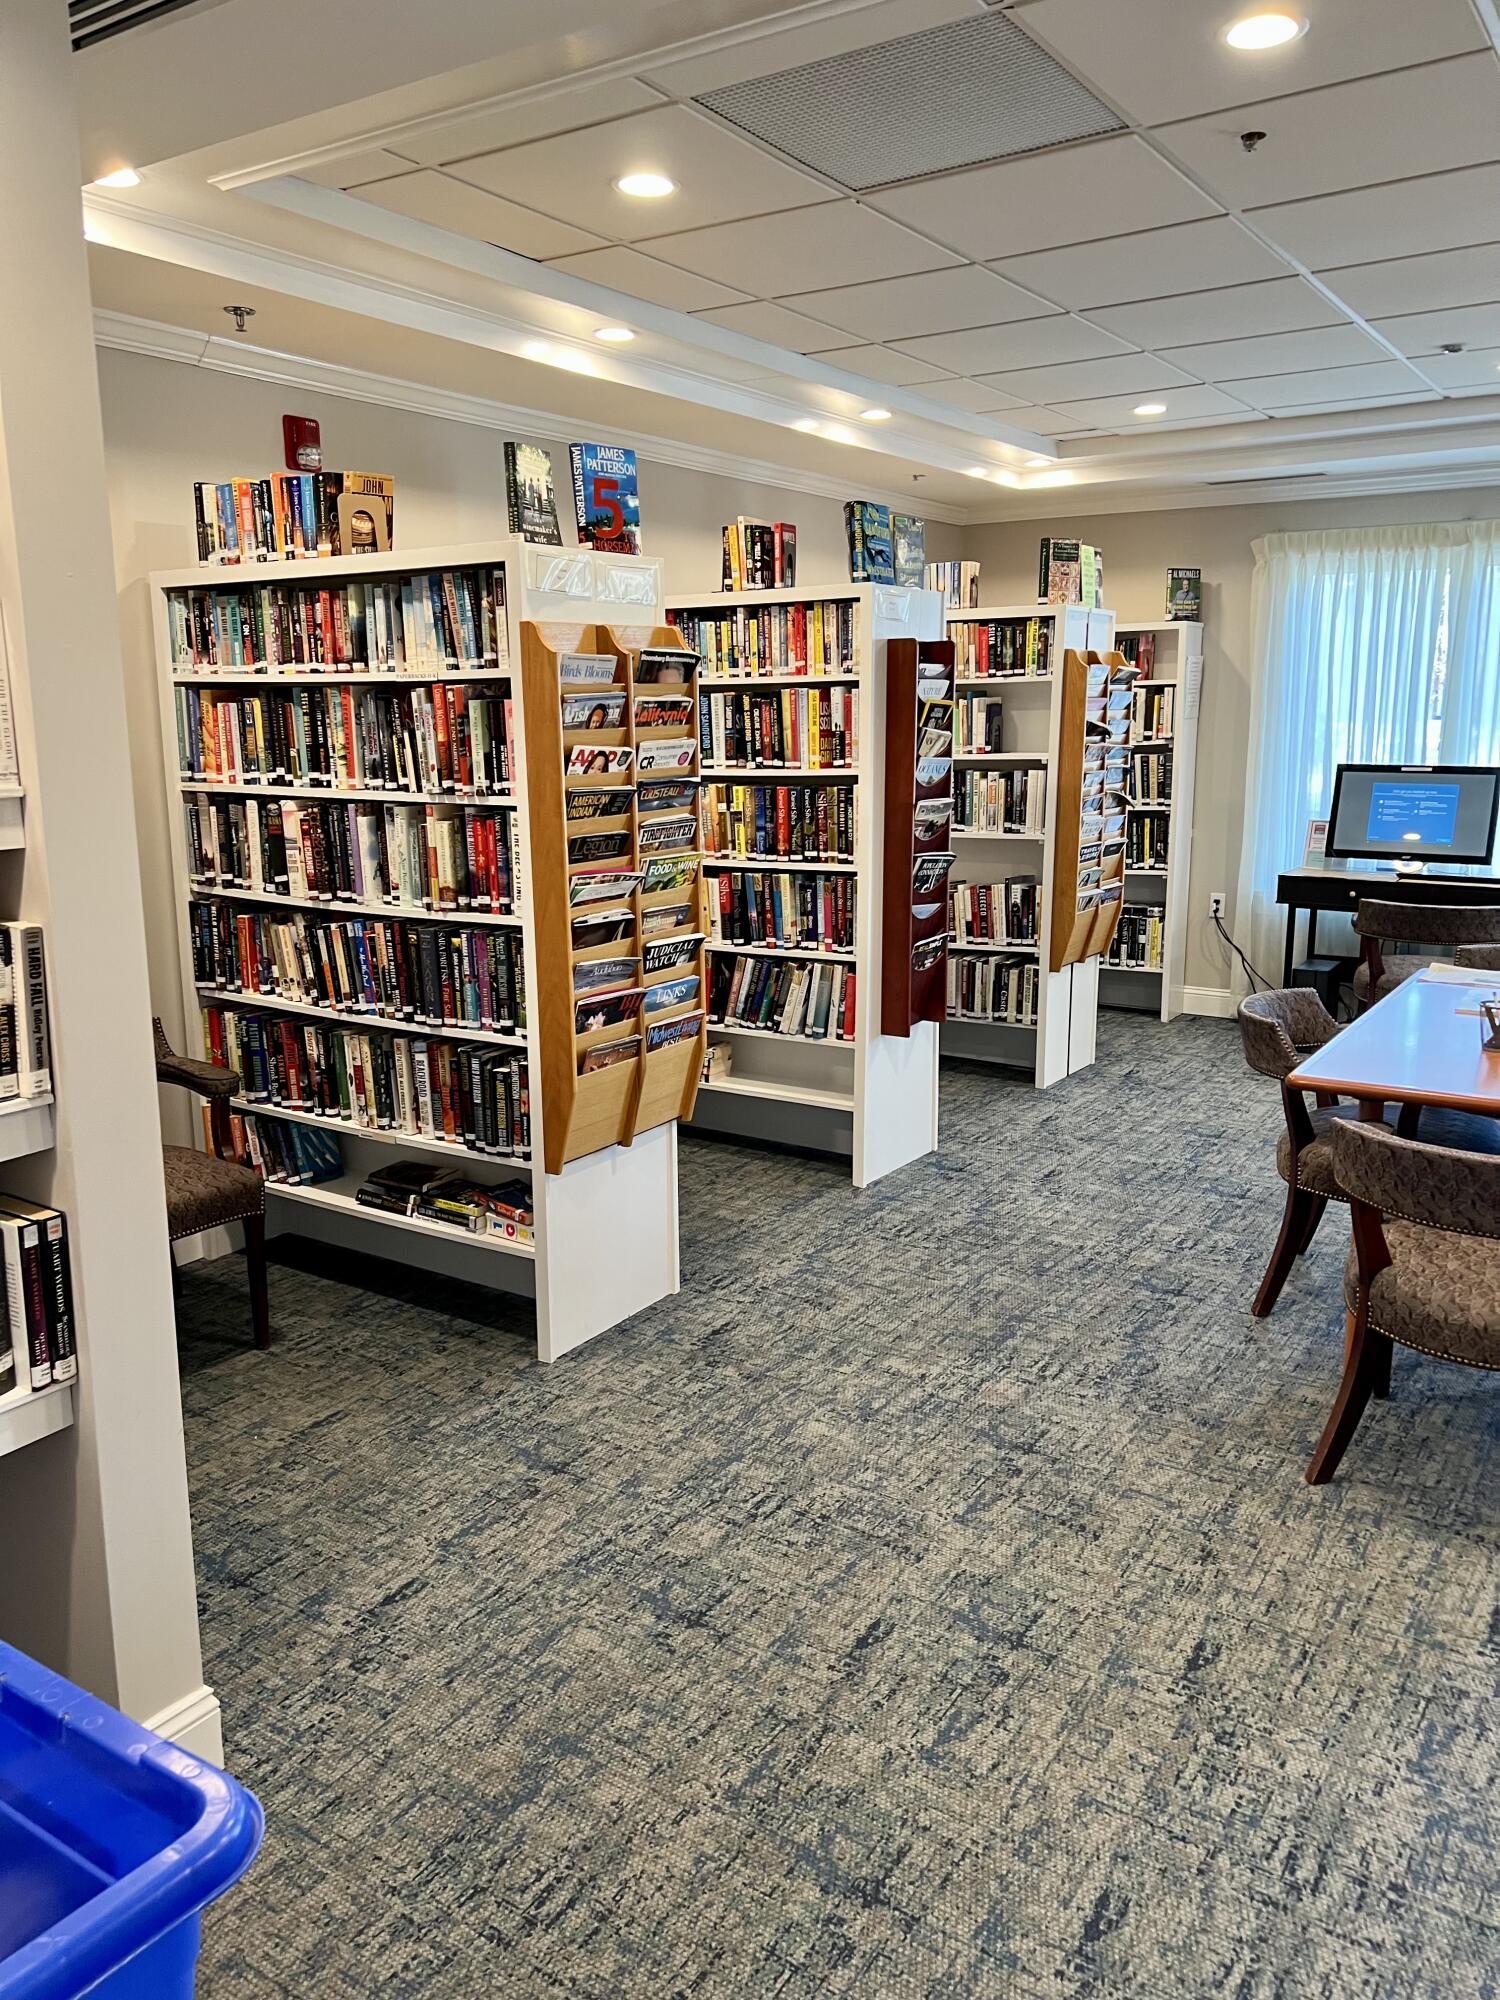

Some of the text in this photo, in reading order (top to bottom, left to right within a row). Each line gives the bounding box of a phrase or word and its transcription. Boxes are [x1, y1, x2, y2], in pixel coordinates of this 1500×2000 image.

[597, 446, 625, 461] JAMES
[587, 459, 636, 476] PATTERSON
[362, 479, 384, 495] JOHN
[571, 447, 587, 526] JAMES PATTERSON
[593, 478, 624, 538] 5
[854, 503, 863, 552] JOHN SANDFORD
[533, 536, 548, 545] wife
[243, 624, 249, 635] ON
[453, 617, 458, 625] US
[194, 617, 202, 651] GRAFTON
[561, 663, 614, 679] Birds Blooms
[634, 707, 688, 723] California
[700, 696, 711, 748] JOHN SANDFORD
[742, 695, 752, 741] JOHN SANDFORD
[639, 755, 654, 770] CR
[571, 794, 610, 807] AMERICAN
[569, 806, 594, 819] INDIAN
[649, 863, 672, 875] FOOD
[678, 859, 700, 870] WINE
[720, 880, 728, 903] Silva
[979, 889, 987, 916] FLEECED
[212, 927, 220, 961] BEAUTIFUL
[438, 932, 447, 950] SARA
[647, 940, 695, 959] JUDICIAL
[28, 947, 41, 979] HARD
[440, 951, 449, 985] PARETSKY
[645, 953, 679, 970] WATCH
[389, 962, 397, 985] PATIENT
[498, 965, 507, 999] BUCKSKIN
[31, 983, 44, 1007] FALL
[656, 985, 687, 1003] LINKS
[1000, 990, 1008, 1012] Caste
[33, 1009, 43, 1034] Ridley
[249, 1023, 260, 1050] PASTIME
[307, 1031, 315, 1051] SWIFT
[269, 1057, 277, 1081] Shrink
[416, 1060, 427, 1097] BEACH ROAD
[471, 1058, 481, 1103] JAMES PATTERSON
[511, 1060, 521, 1120] JAMES PATTERSON DOUBLE
[496, 1081, 506, 1128] JAMES PATTERSON
[51, 1240, 66, 1313] TUART WOODS
